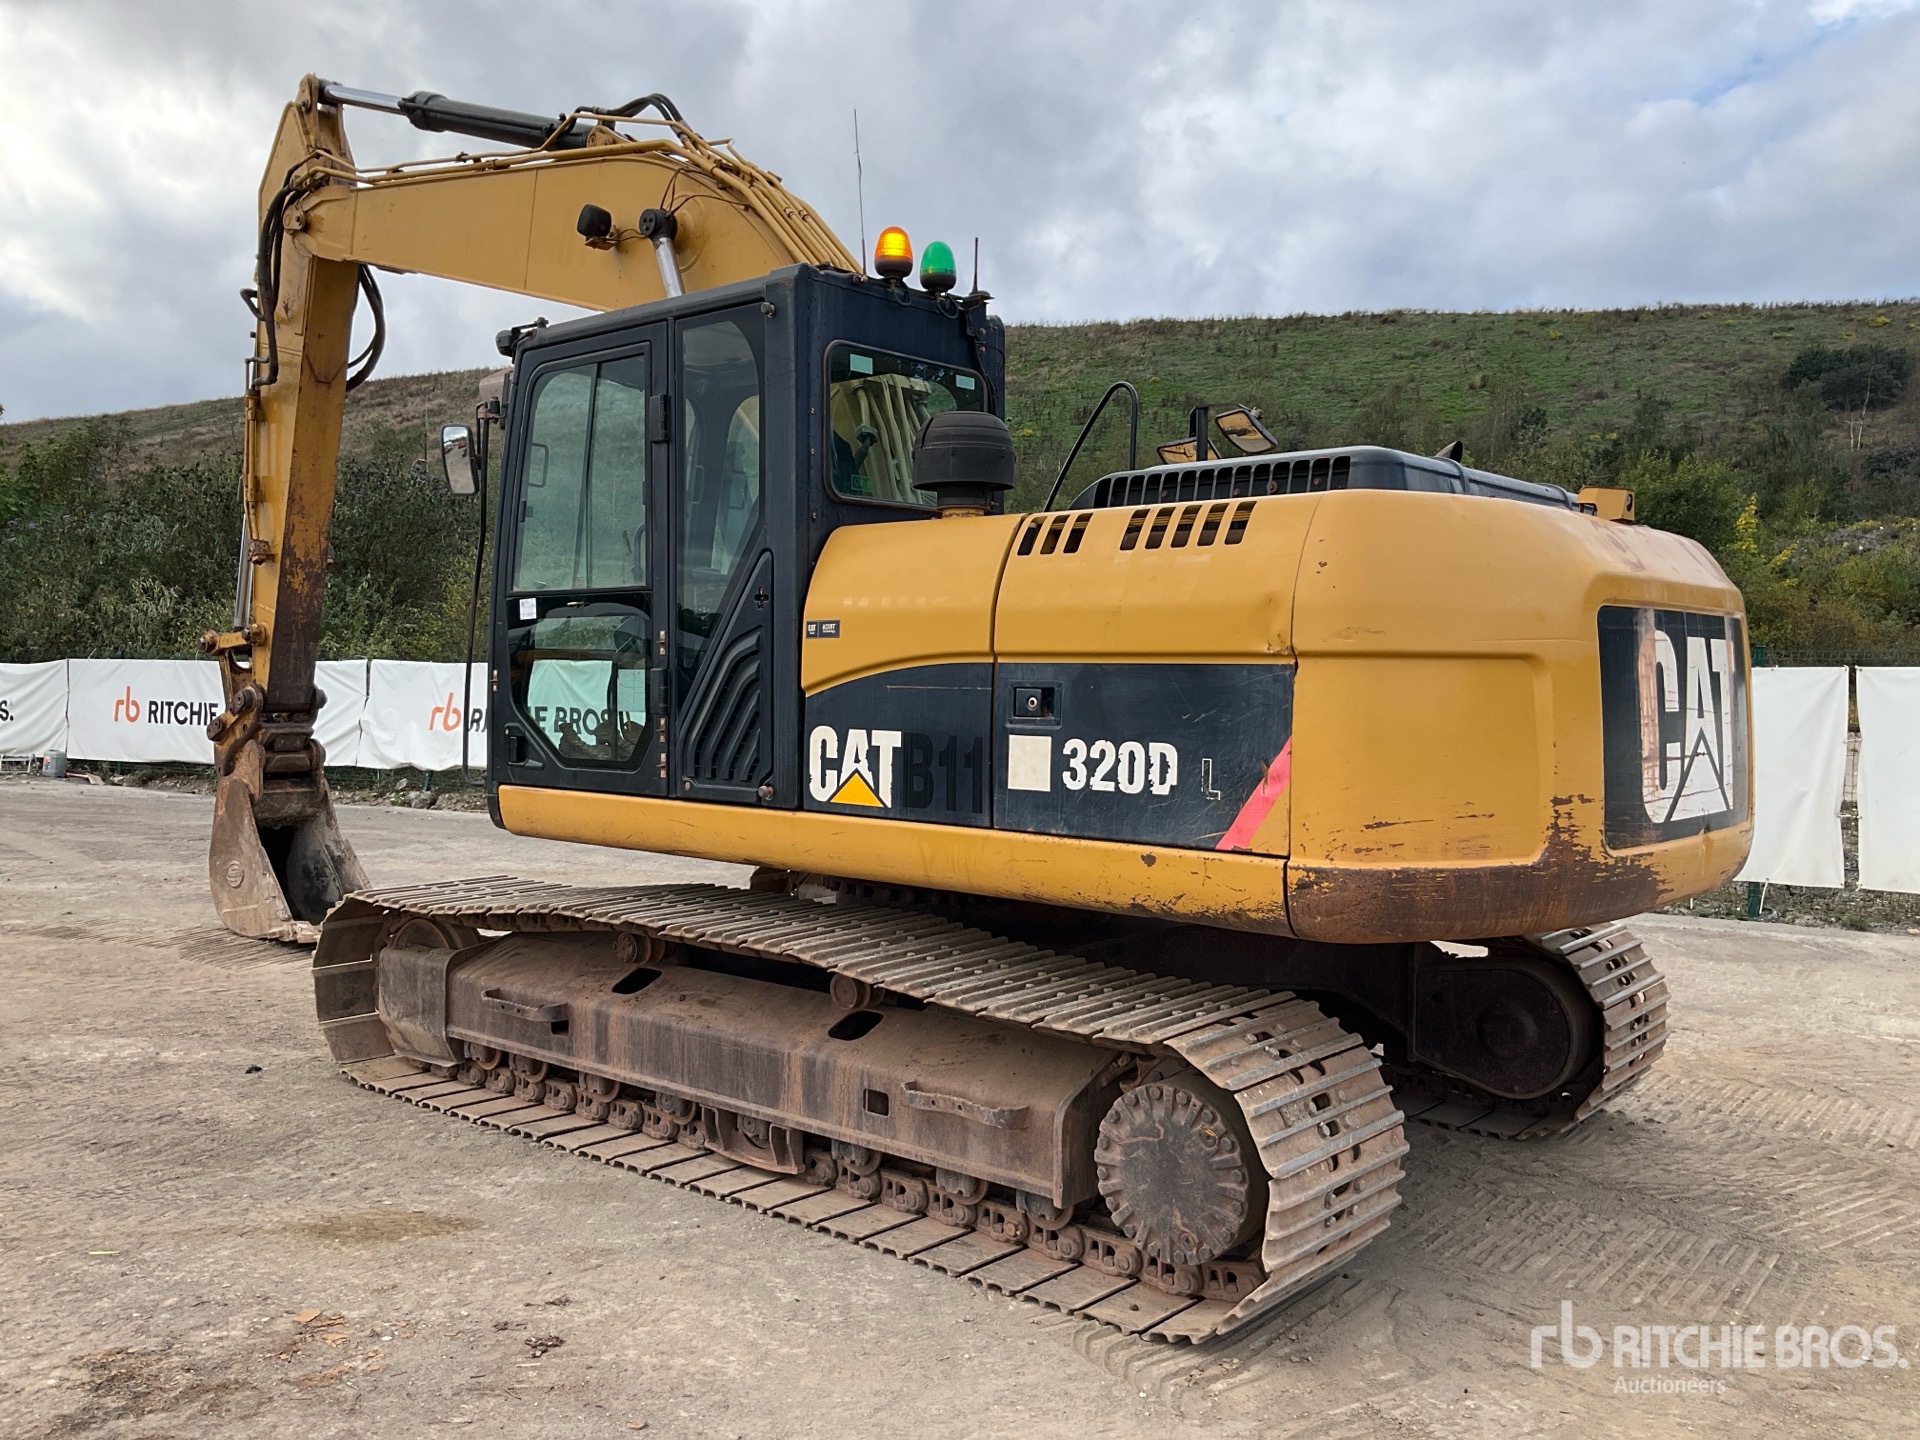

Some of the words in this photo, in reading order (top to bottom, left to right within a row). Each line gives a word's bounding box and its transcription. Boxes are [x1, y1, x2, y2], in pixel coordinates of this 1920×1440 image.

[808, 725, 902, 808] CAT
[1638, 629, 1734, 823] CAT
[903, 732, 984, 814] B11
[1062, 738, 1178, 795] 320D
[1201, 757, 1221, 800] L
